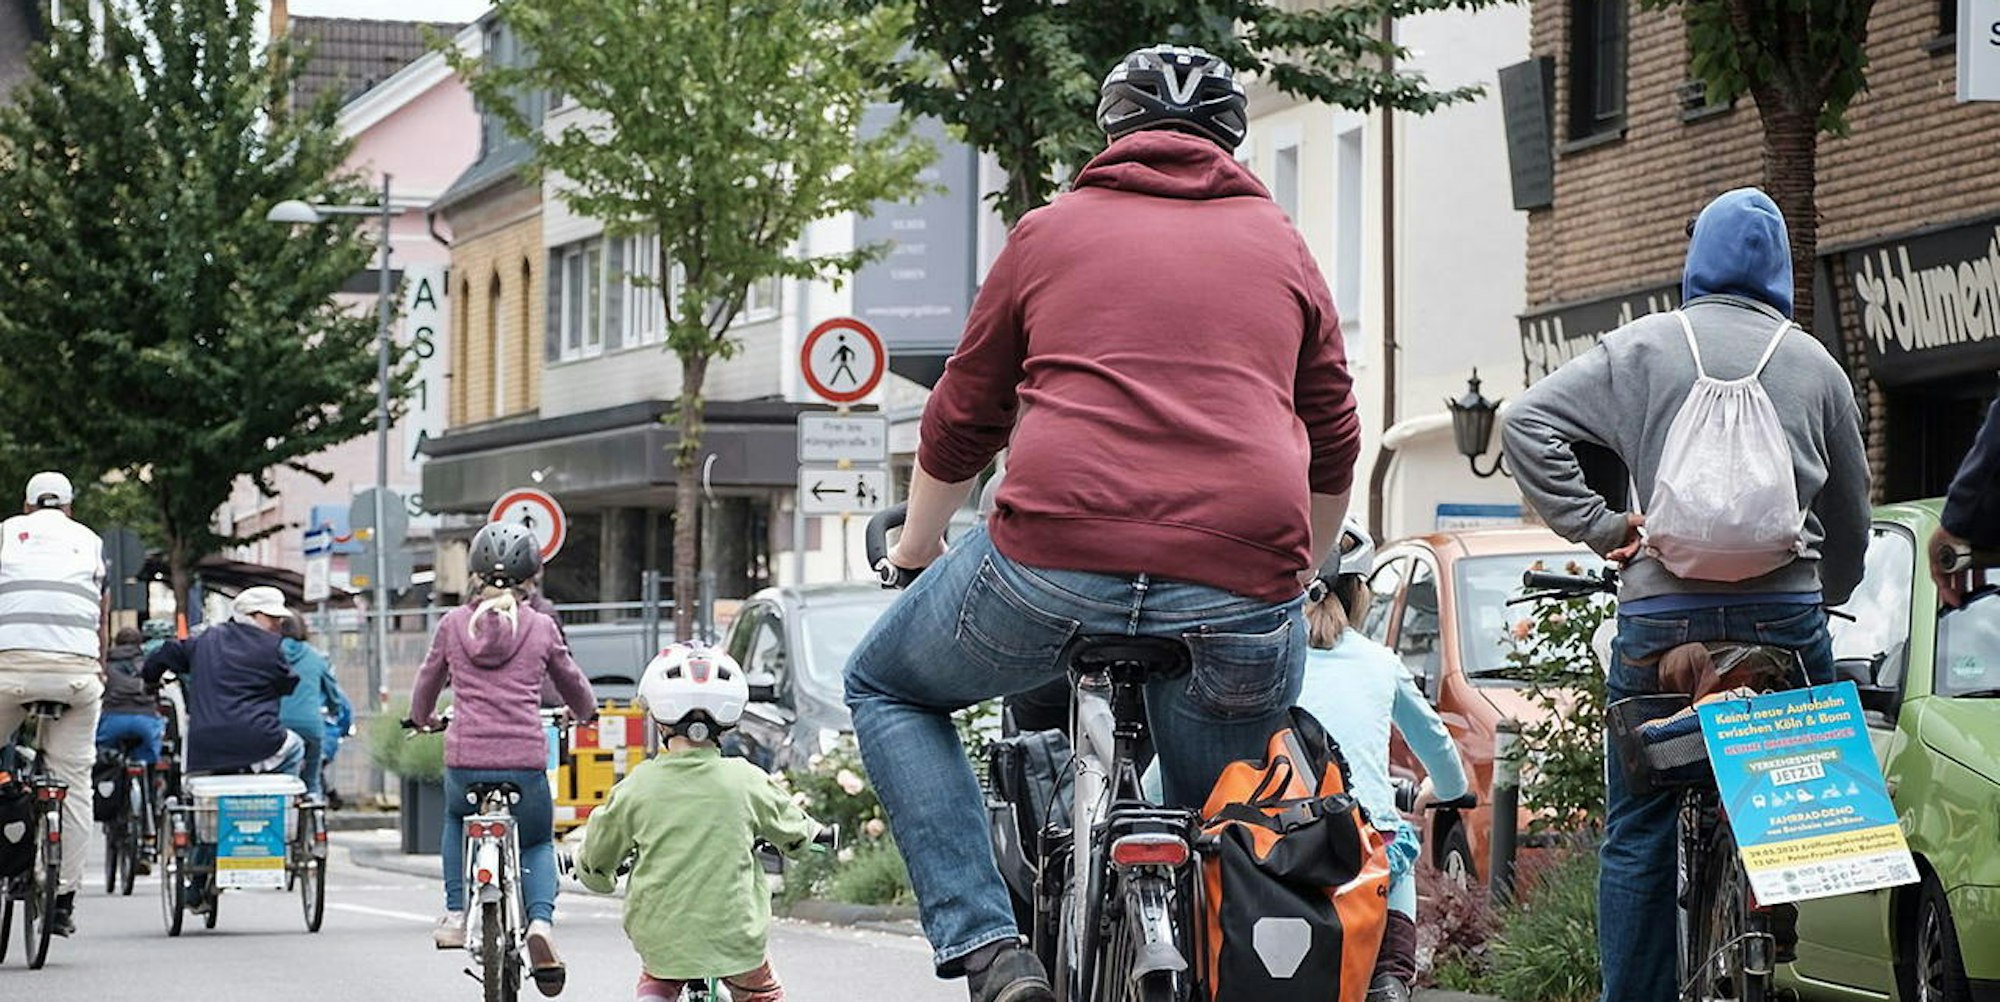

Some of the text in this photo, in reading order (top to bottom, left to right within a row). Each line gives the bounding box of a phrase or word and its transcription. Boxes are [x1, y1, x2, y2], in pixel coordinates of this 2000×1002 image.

[1715, 696, 1845, 725] Keine neue Autobahn
[1717, 711, 1851, 739] zwischen Köln & Bonn
[1749, 750, 1838, 771] VERKEHRSWENDE
[1774, 766, 1821, 783] JETZT!
